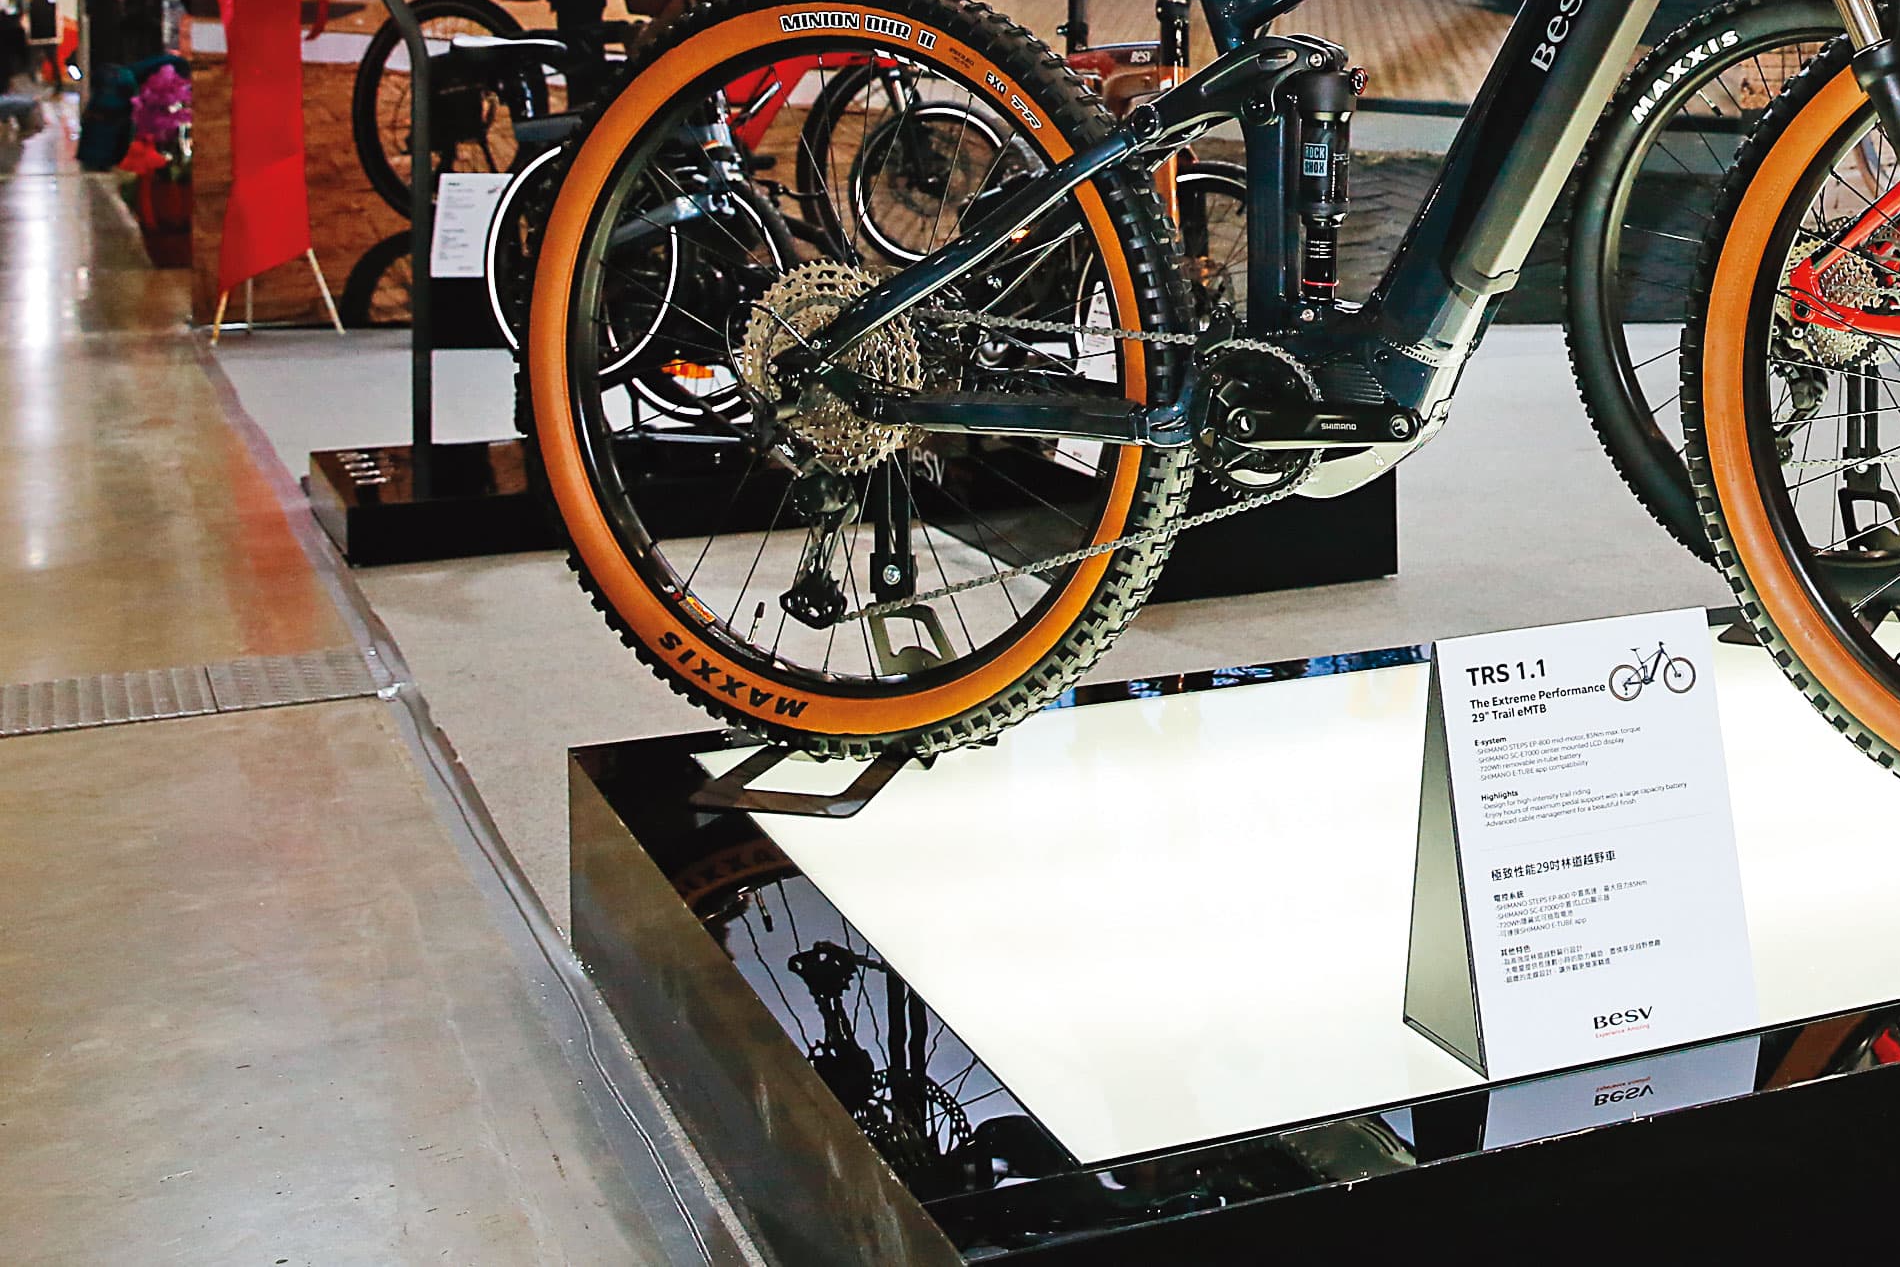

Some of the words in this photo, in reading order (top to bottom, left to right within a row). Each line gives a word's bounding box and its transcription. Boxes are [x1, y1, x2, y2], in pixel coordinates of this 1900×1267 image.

[779, 11, 860, 32] MINION
[864, 14, 912, 41] DHR
[917, 29, 937, 50] II
[984, 70, 1007, 95] EXO
[1630, 28, 1739, 125] MAXXIS
[1319, 421, 1357, 432] SHIMANO
[657, 630, 809, 719] MAXXIS
[1466, 663, 1510, 686] TRS
[1516, 659, 1545, 680] 1.1
[1470, 698, 1490, 709] The
[1492, 692, 1536, 706] Extreme
[1539, 682, 1606, 699] Performance
[1492, 708, 1515, 720] Trail
[1517, 704, 1547, 716] eMTB
[1559, 752, 1581, 761] battery
[1481, 790, 1519, 801] Highlights
[1530, 802, 1561, 811] maximum
[1562, 798, 1580, 807] pedal
[1580, 795, 1604, 804] support
[1624, 789, 1640, 797] large
[1641, 785, 1665, 794] capacity
[1665, 782, 1687, 791] battery
[1573, 788, 1591, 796] riding
[1518, 814, 1535, 822] cable
[1535, 808, 1577, 820] management
[1592, 801, 1619, 810] beautiful
